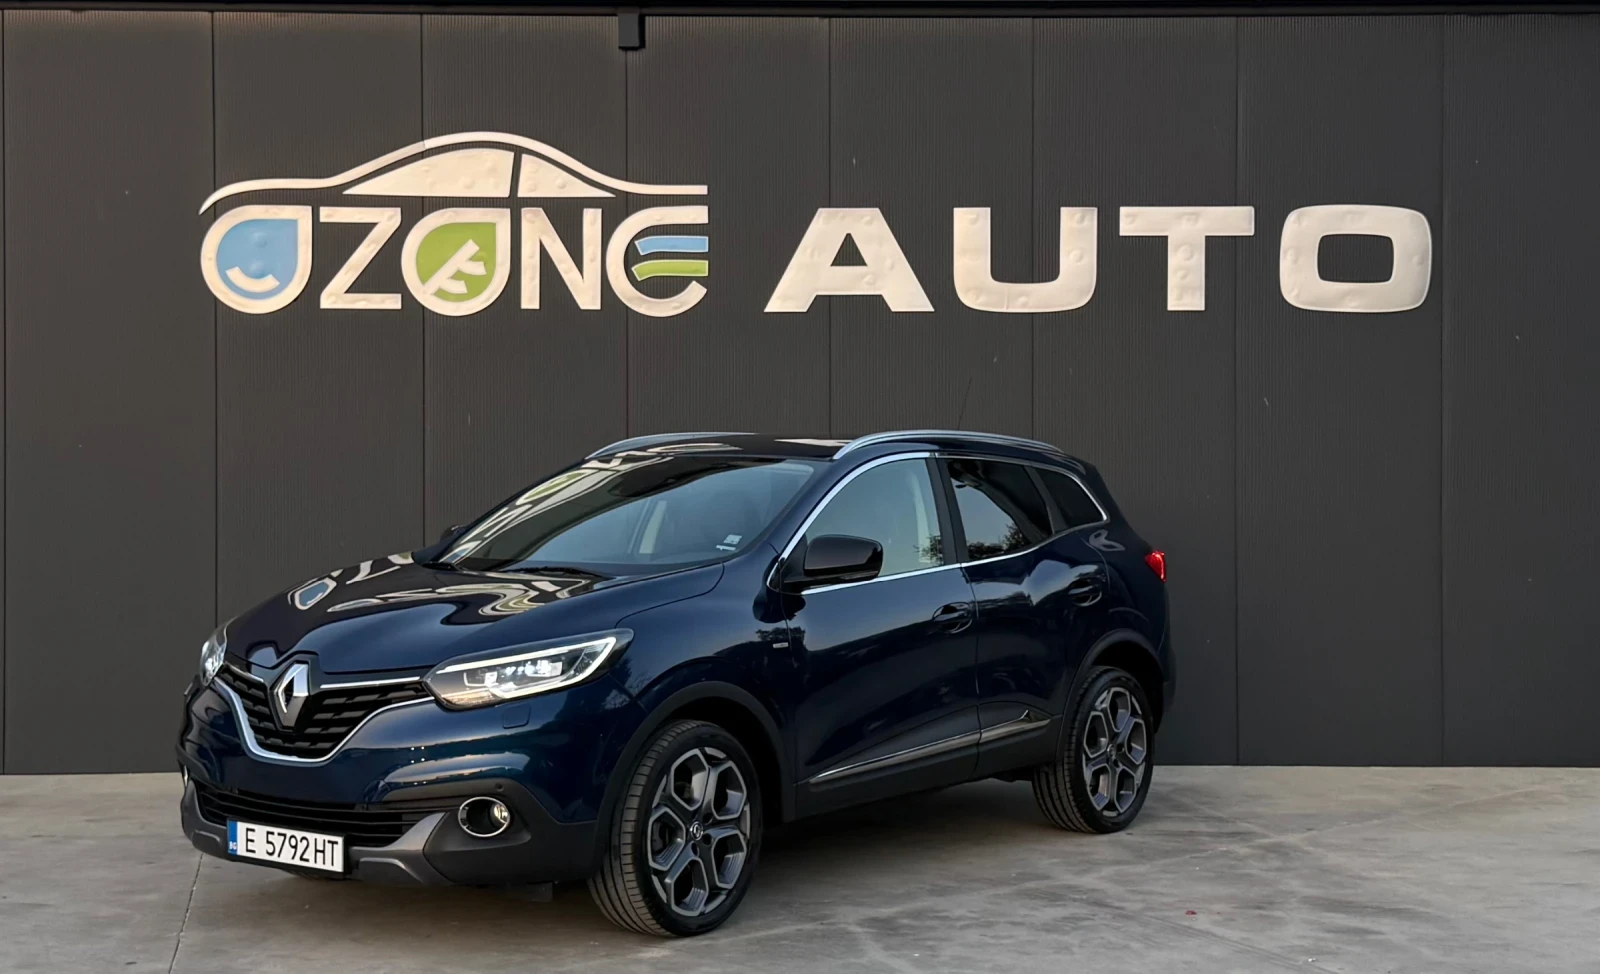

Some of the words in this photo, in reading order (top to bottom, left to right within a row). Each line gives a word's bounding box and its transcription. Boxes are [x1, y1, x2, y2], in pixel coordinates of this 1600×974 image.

[200, 205, 708, 317] OZONE
[763, 204, 1432, 313] AUTO
[245, 827, 256, 854] E
